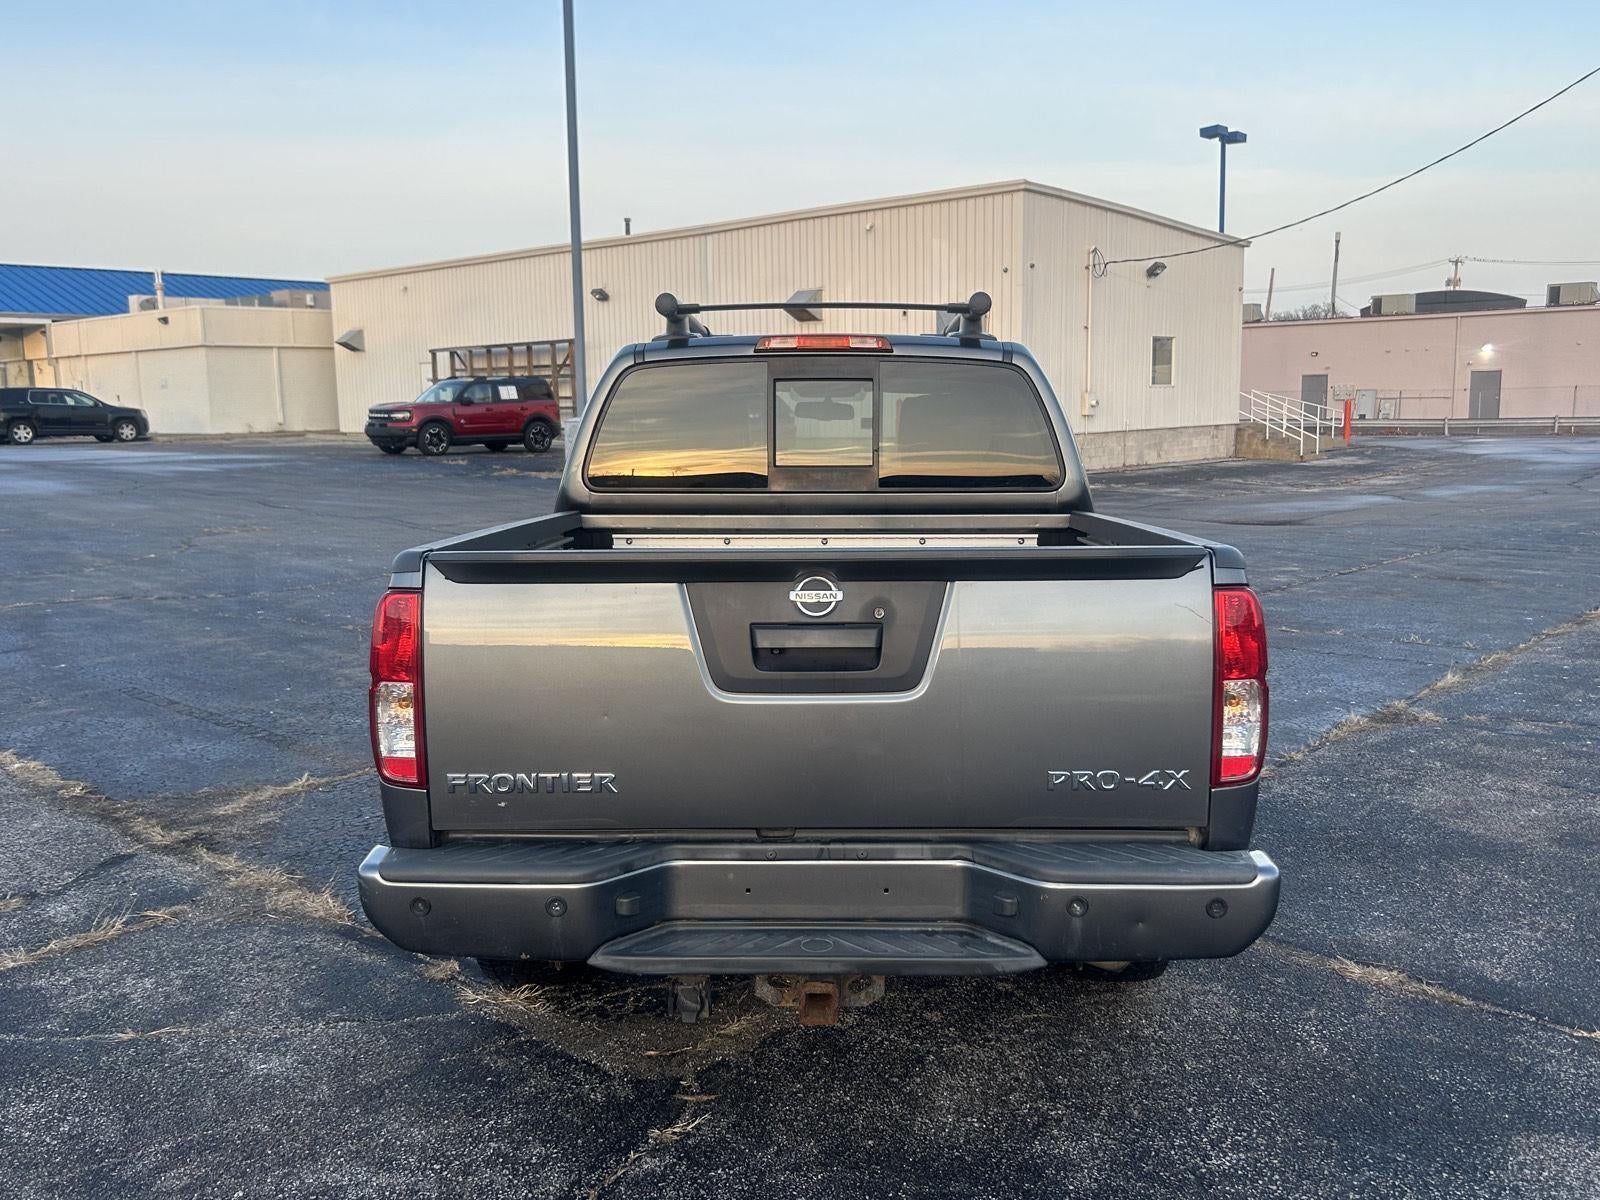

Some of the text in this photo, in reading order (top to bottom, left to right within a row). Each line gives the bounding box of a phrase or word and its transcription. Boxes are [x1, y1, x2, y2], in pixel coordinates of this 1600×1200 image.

[795, 592, 838, 600] NISSAN
[446, 772, 618, 794] FRONTIER
[1047, 769, 1192, 791] PRO-4X
